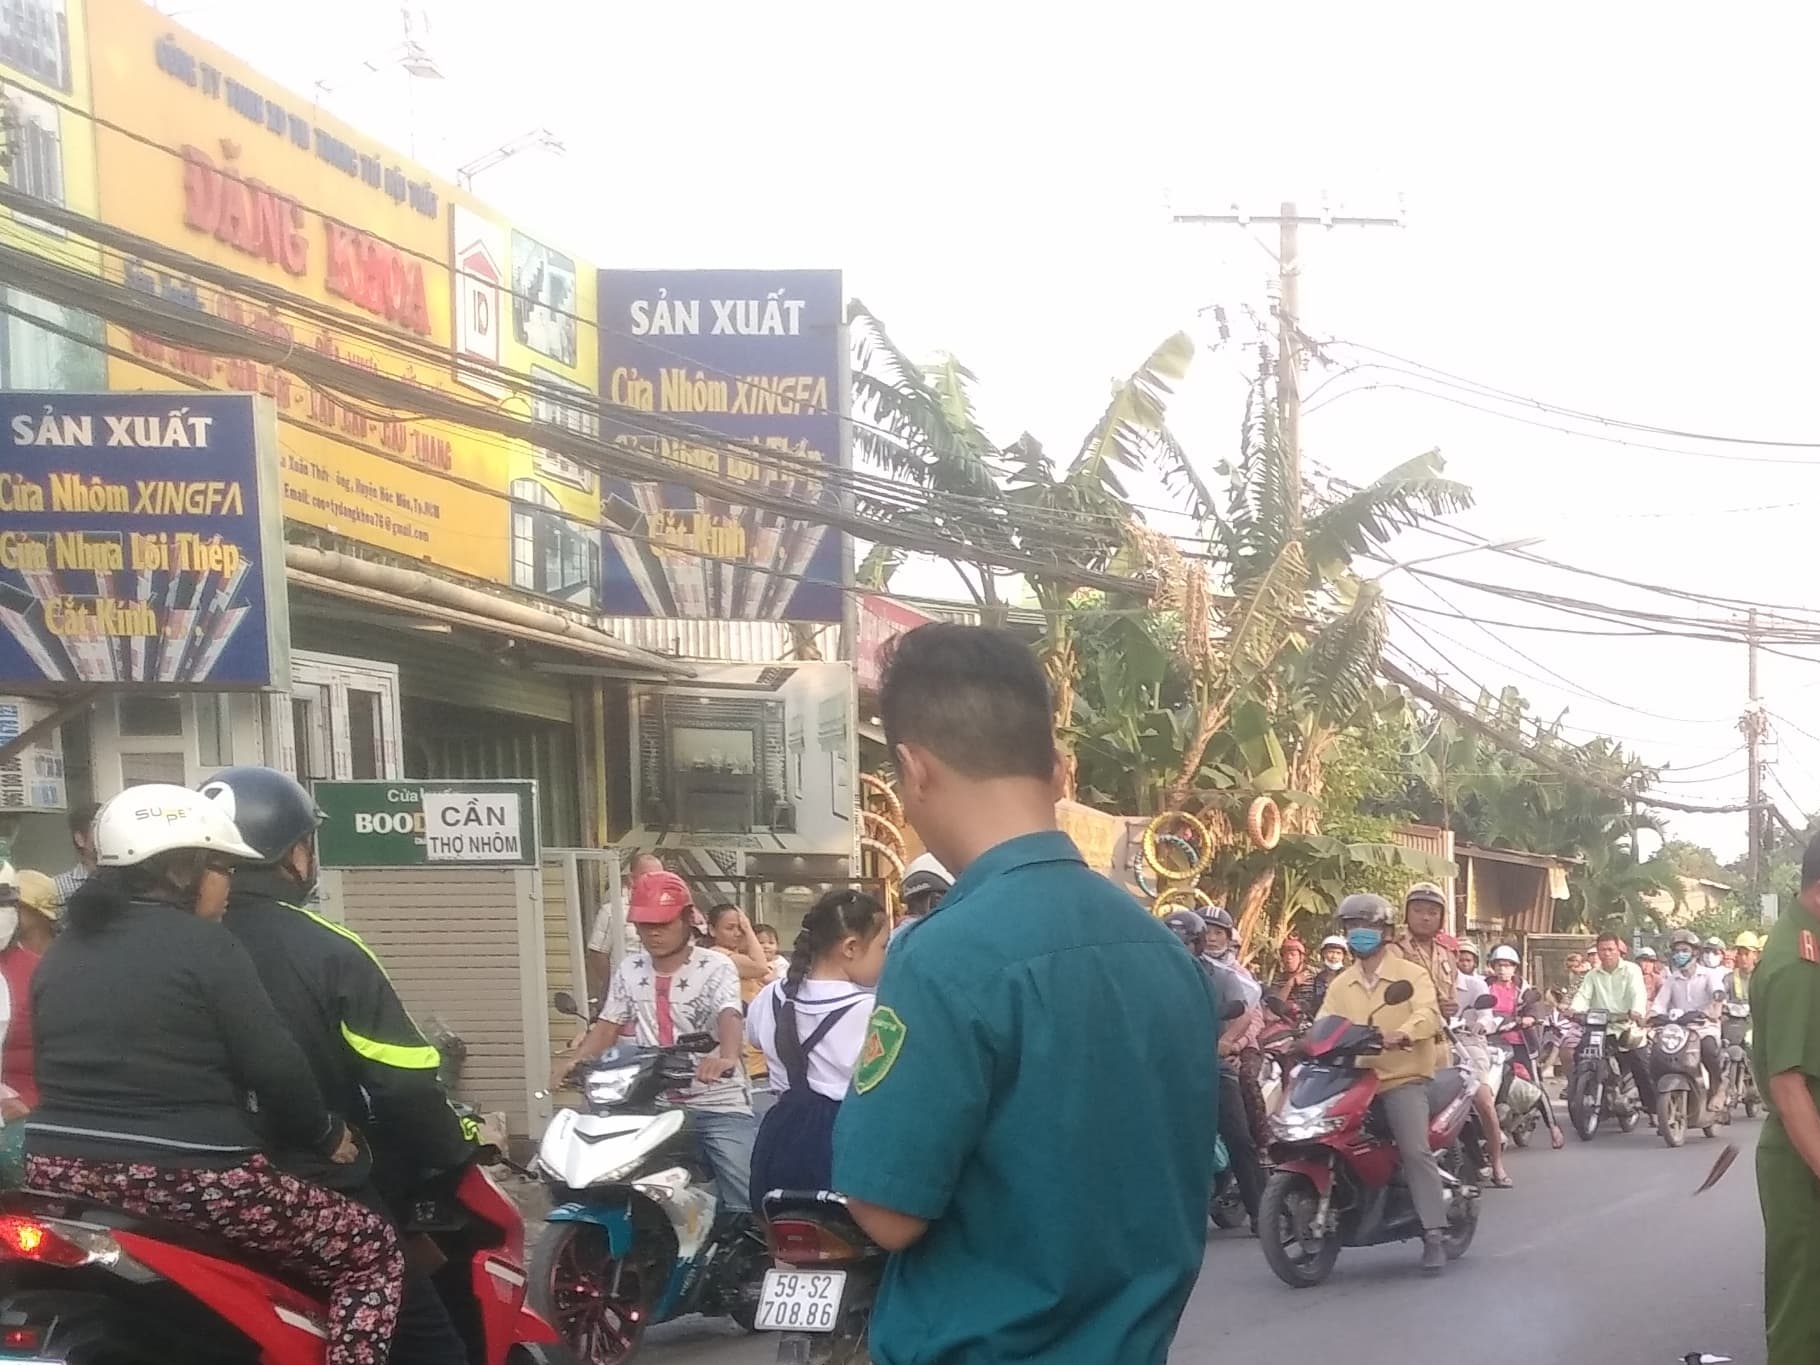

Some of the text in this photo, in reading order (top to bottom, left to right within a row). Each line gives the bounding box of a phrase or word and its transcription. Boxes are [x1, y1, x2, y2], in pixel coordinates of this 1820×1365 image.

[630, 287, 806, 336] SẢN XUẤT
[659, 368, 728, 413] Nhôm
[730, 374, 828, 416] XINGFA
[11, 404, 213, 449] SẢN XUẤT
[49, 473, 130, 513] Nhôm
[132, 480, 245, 516] XINGFA
[175, 532, 241, 579] Thép
[387, 788, 419, 802] Cửa
[440, 798, 506, 827] CẦN
[429, 834, 465, 854] THỢ
[468, 832, 518, 854] NHÔM
[774, 1275, 832, 1300] 59-S2
[762, 1300, 833, 1327] 708.86
